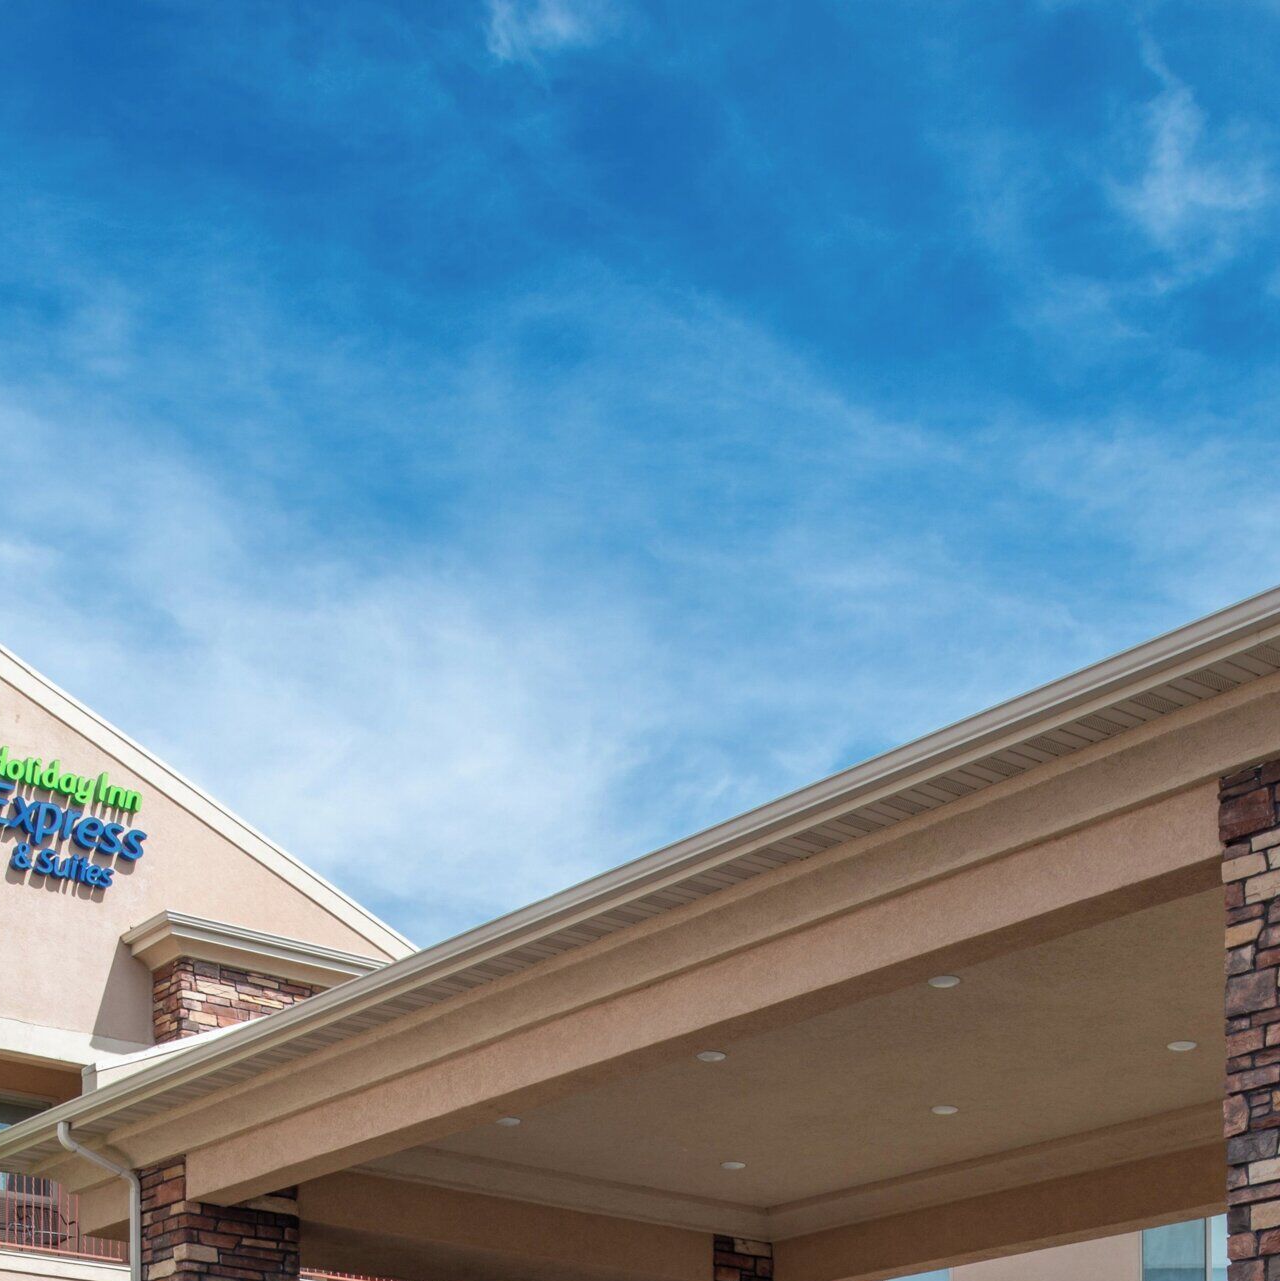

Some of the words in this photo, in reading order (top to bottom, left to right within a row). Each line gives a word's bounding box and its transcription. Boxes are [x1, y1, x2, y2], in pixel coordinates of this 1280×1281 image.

[96, 773, 143, 812] Inn
[11, 842, 33, 871] &
[34, 848, 114, 888] Suites
